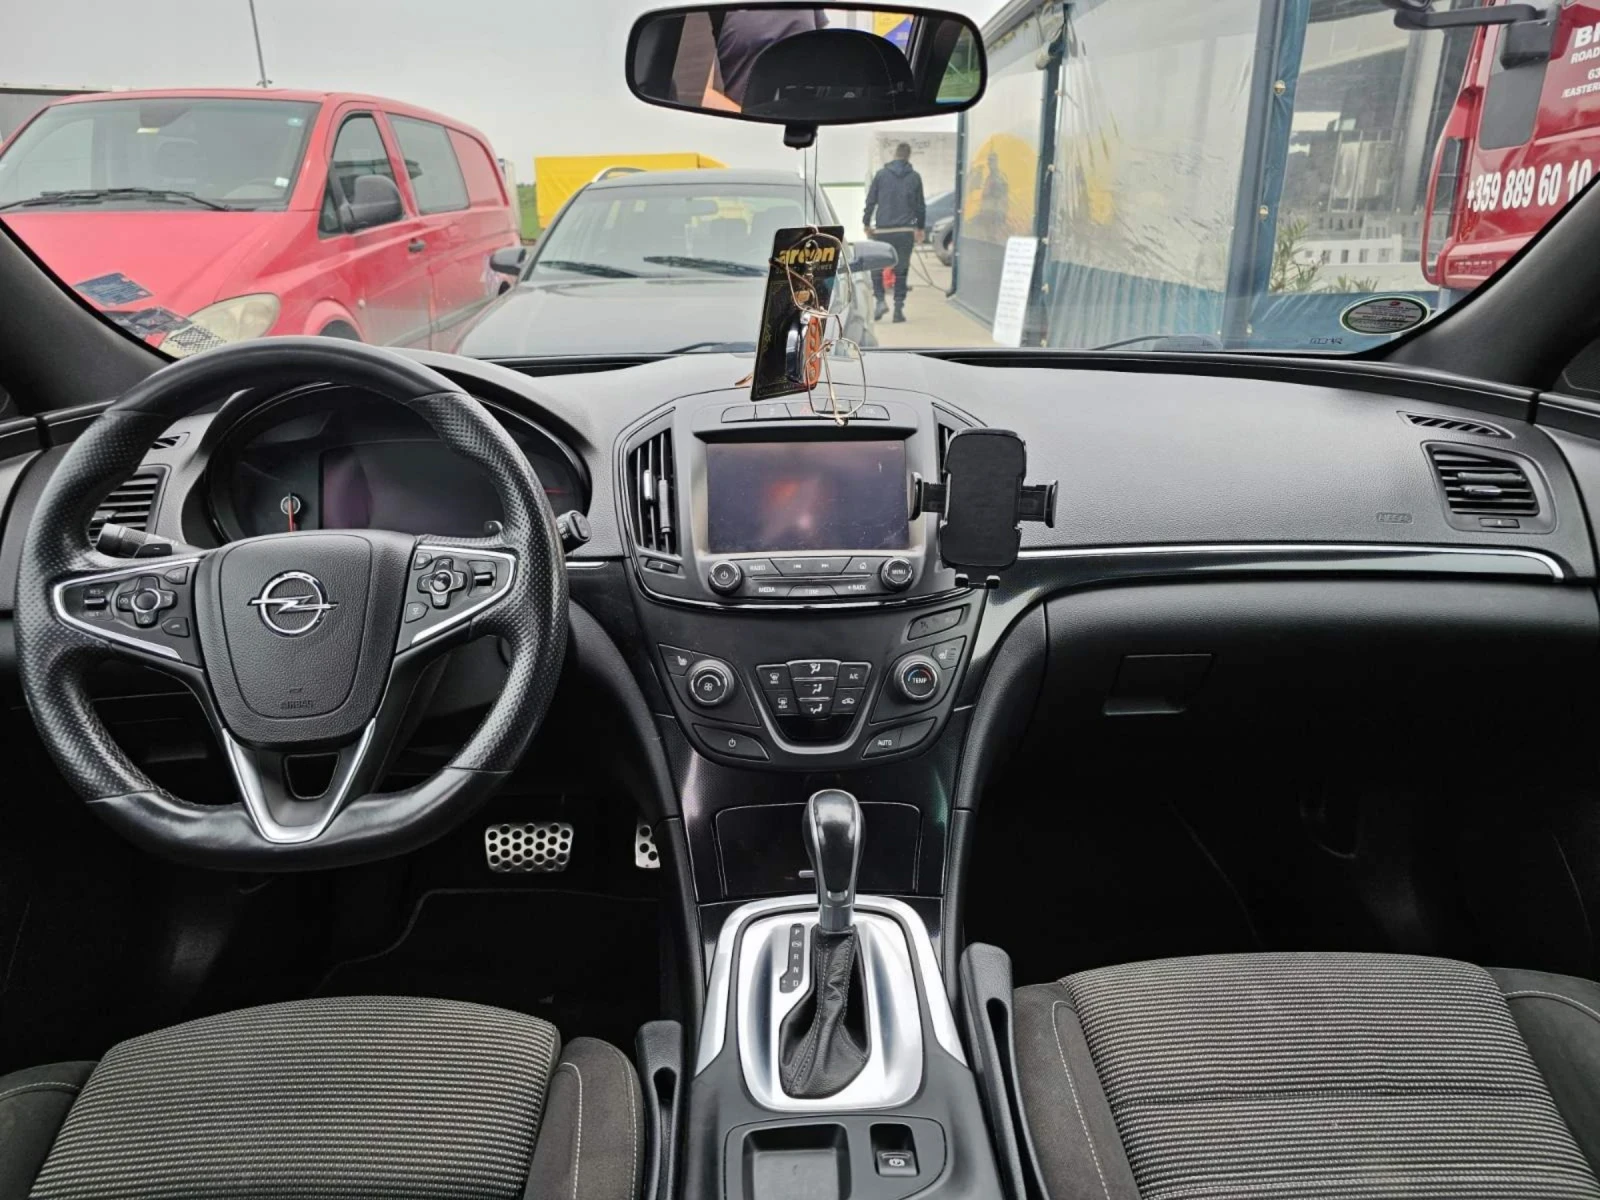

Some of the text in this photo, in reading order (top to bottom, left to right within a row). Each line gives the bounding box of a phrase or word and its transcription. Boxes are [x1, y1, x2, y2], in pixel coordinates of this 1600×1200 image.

[1467, 171, 1501, 212] +359
[1502, 166, 1535, 209] 889
[1538, 163, 1562, 206] 60
